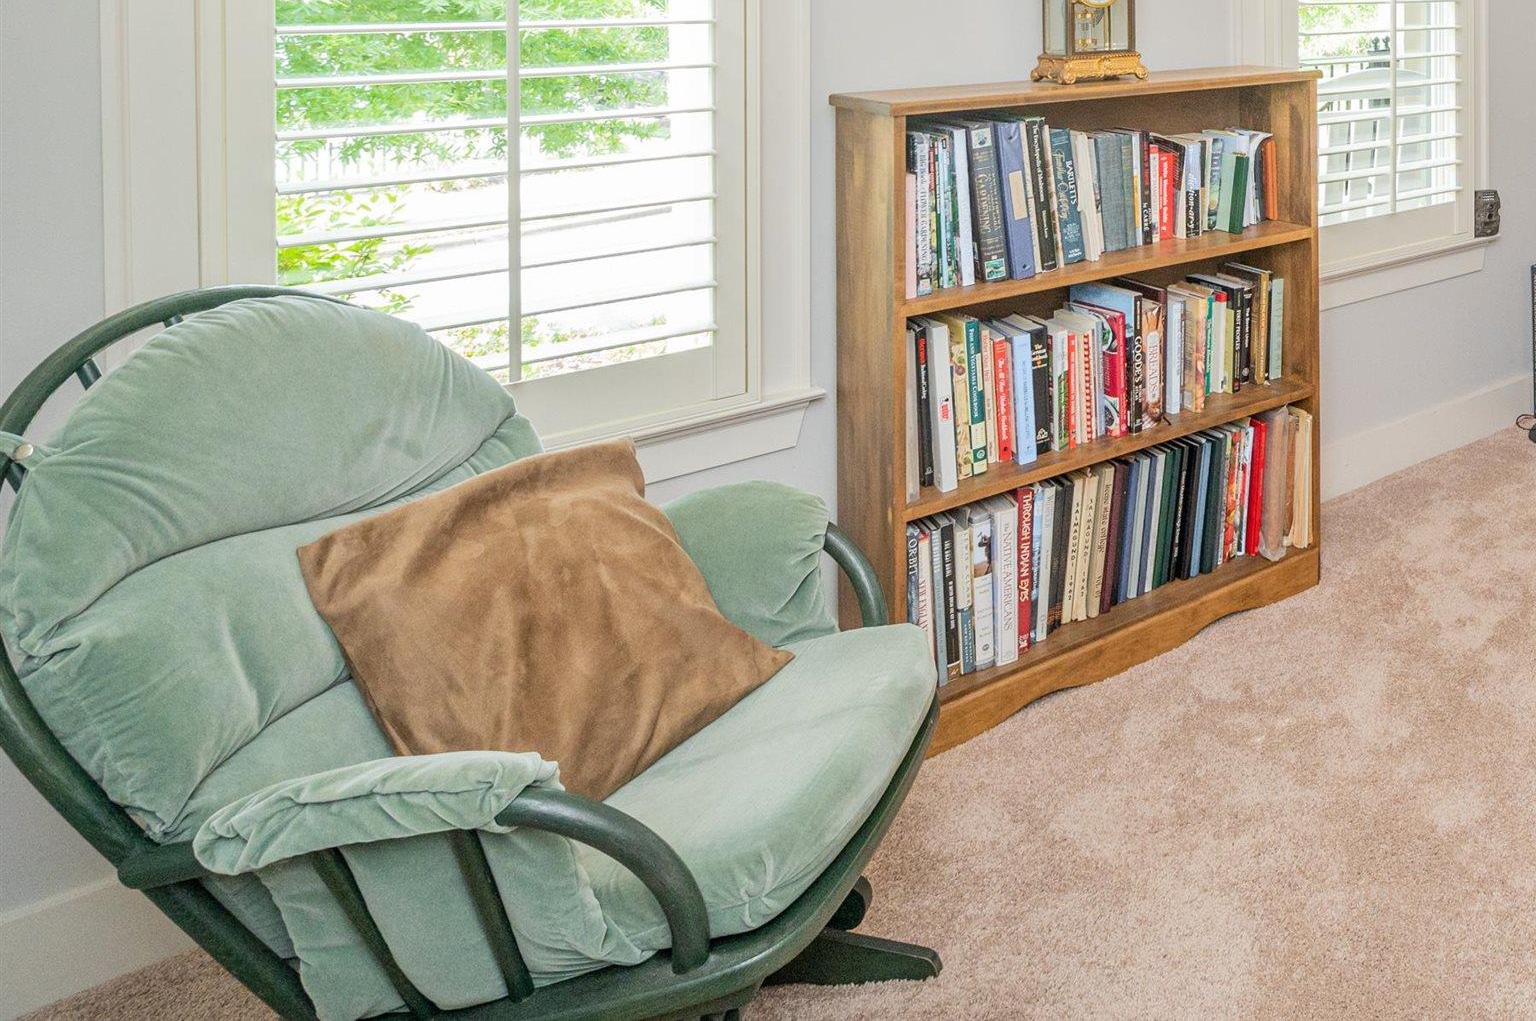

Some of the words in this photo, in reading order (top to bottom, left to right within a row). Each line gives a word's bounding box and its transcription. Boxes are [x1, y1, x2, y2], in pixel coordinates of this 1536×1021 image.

[1021, 492, 1032, 541] THROUGH
[907, 538, 919, 576] ORBIT
[1001, 531, 1013, 571] NATIVE
[1020, 543, 1030, 576] INDIAN
[1002, 571, 1014, 631] AMERICANS
[1019, 579, 1029, 602] EYES
